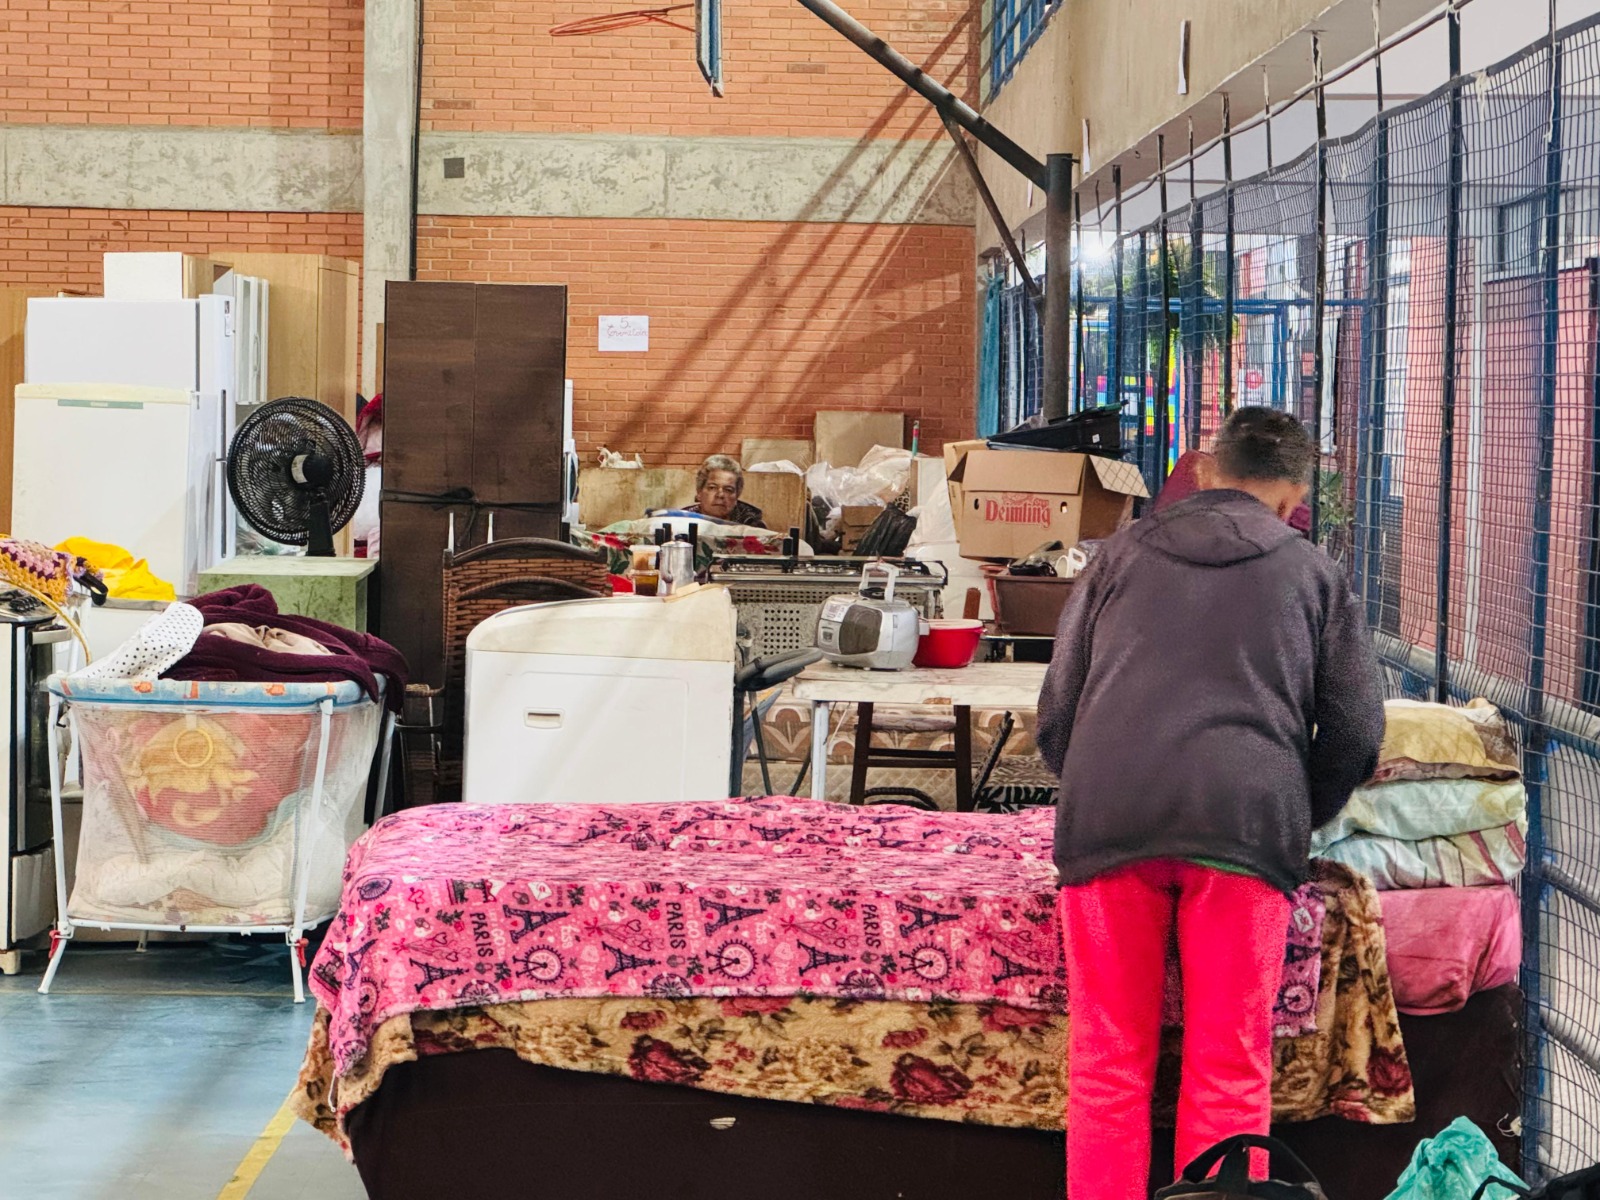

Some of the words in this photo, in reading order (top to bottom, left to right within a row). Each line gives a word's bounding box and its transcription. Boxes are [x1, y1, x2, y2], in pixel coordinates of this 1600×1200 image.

[985, 500, 1051, 529] Deimling
[469, 912, 494, 957] PARIS
[490, 928, 506, 946] GO
[666, 902, 687, 949] PARIS
[686, 920, 700, 938] GO
[861, 903, 881, 949] PARIS
[881, 920, 895, 938] GO
